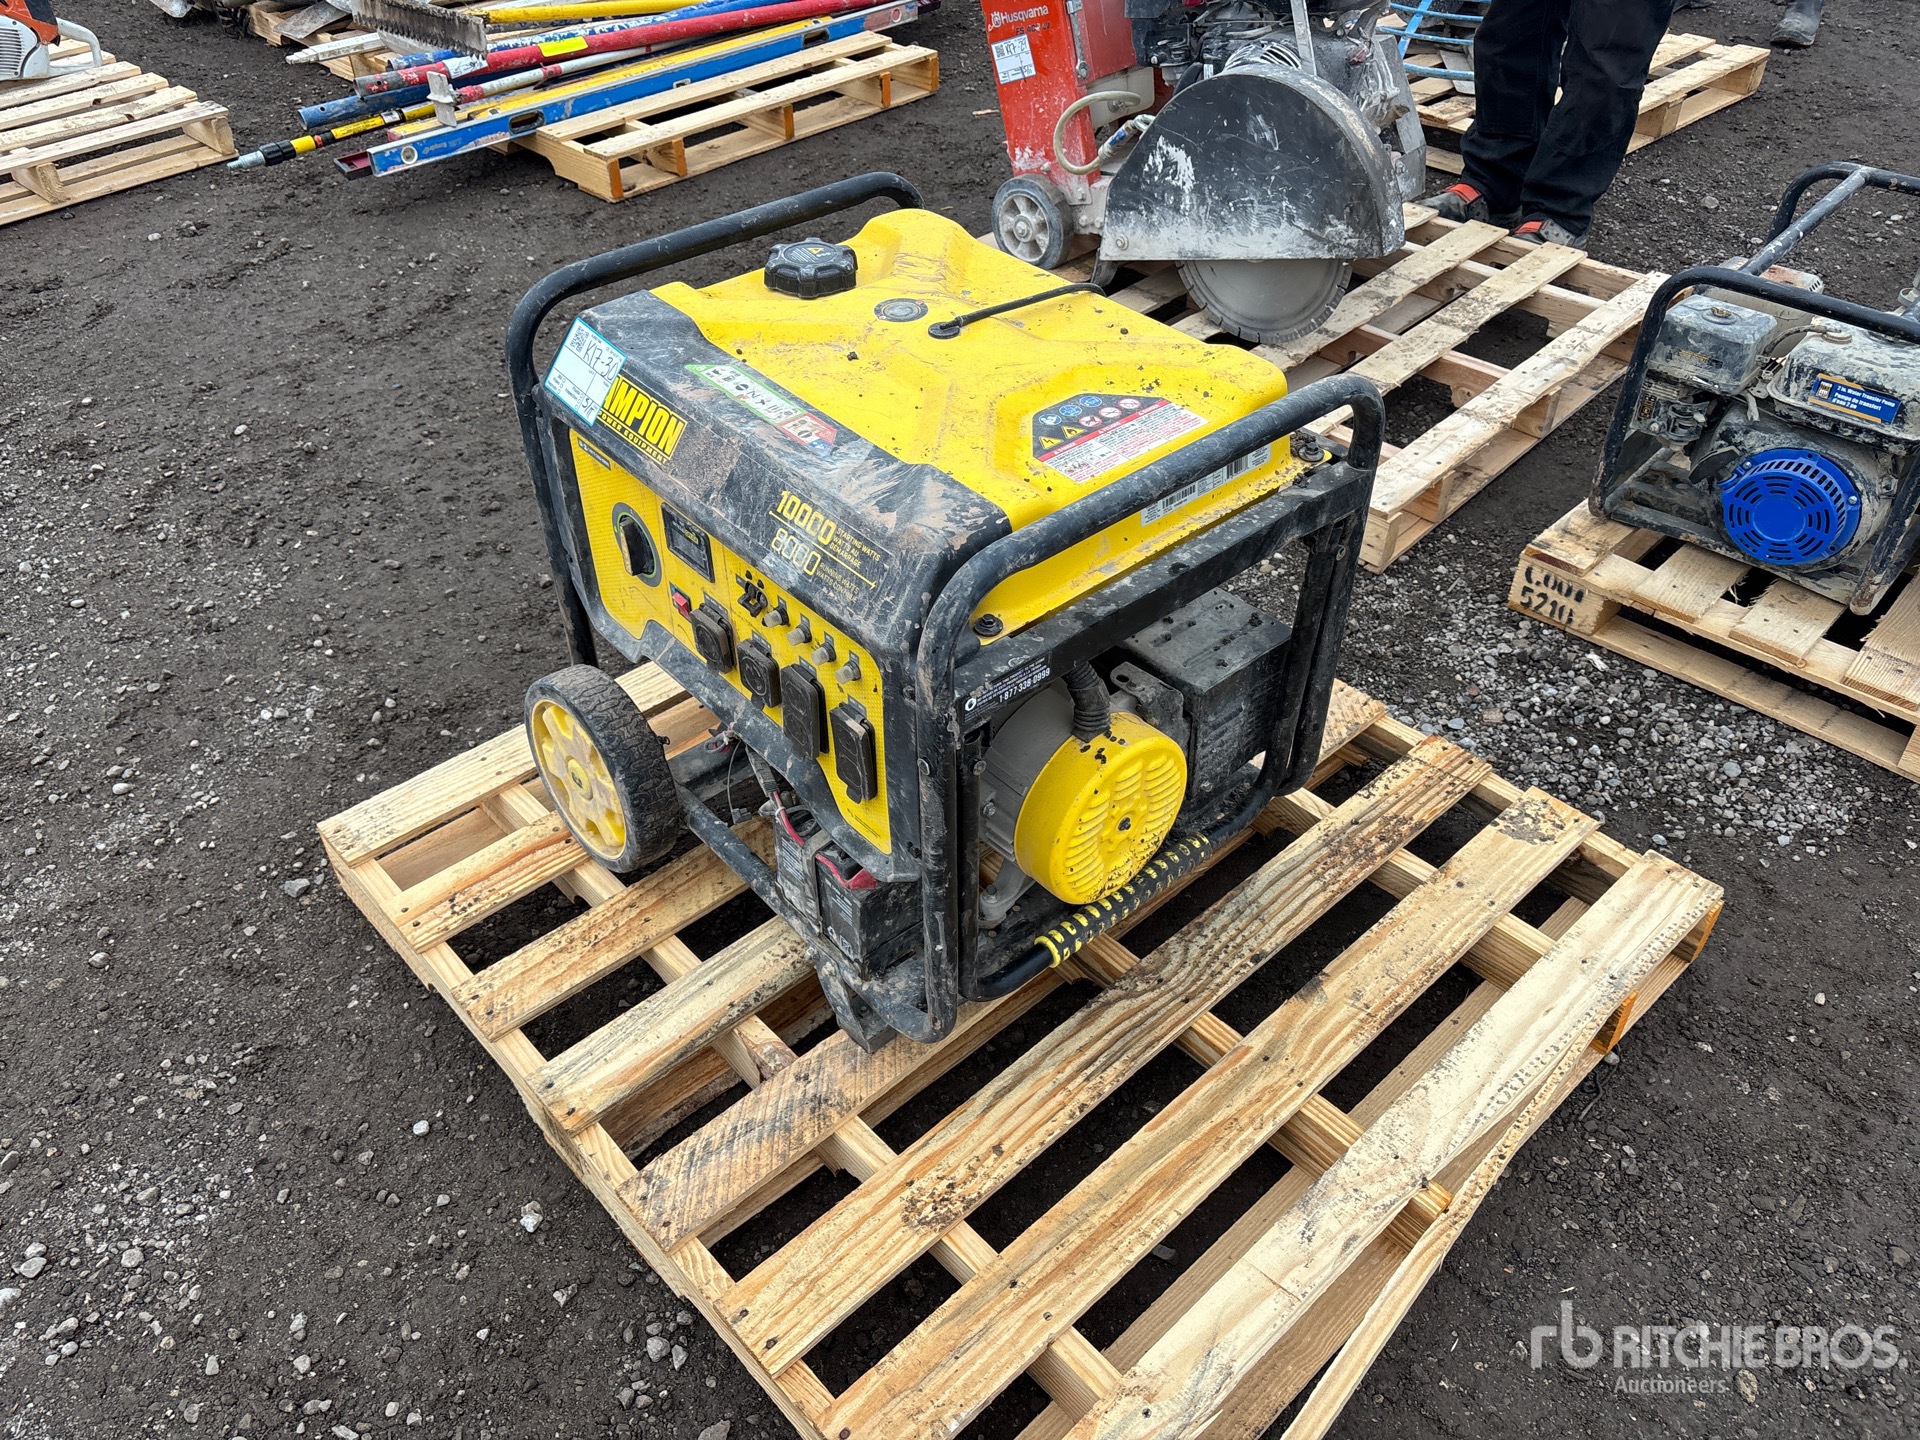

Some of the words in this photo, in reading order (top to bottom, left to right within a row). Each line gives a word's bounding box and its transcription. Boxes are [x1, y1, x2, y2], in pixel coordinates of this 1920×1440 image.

[1000, 5, 1048, 24] Husqvarna
[583, 340, 619, 381] K17-30
[1832, 398, 1845, 407] d'eau
[1834, 392, 1851, 402] Pompe
[1859, 399, 1881, 411] transfert
[1847, 388, 1862, 397] Water
[1862, 392, 1882, 403] Transfer
[1881, 398, 1896, 408] Pump
[623, 430, 668, 464] EQUIPMENT
[777, 490, 837, 545] 10000
[836, 528, 862, 549] STARTING
[861, 545, 881, 562] WATTS
[833, 536, 851, 551] WATTS
[851, 548, 860, 557] AU
[771, 527, 821, 576] 8000
[820, 562, 842, 583] RUNNING
[841, 576, 860, 594] WATTS
[816, 570, 833, 585] WATTS
